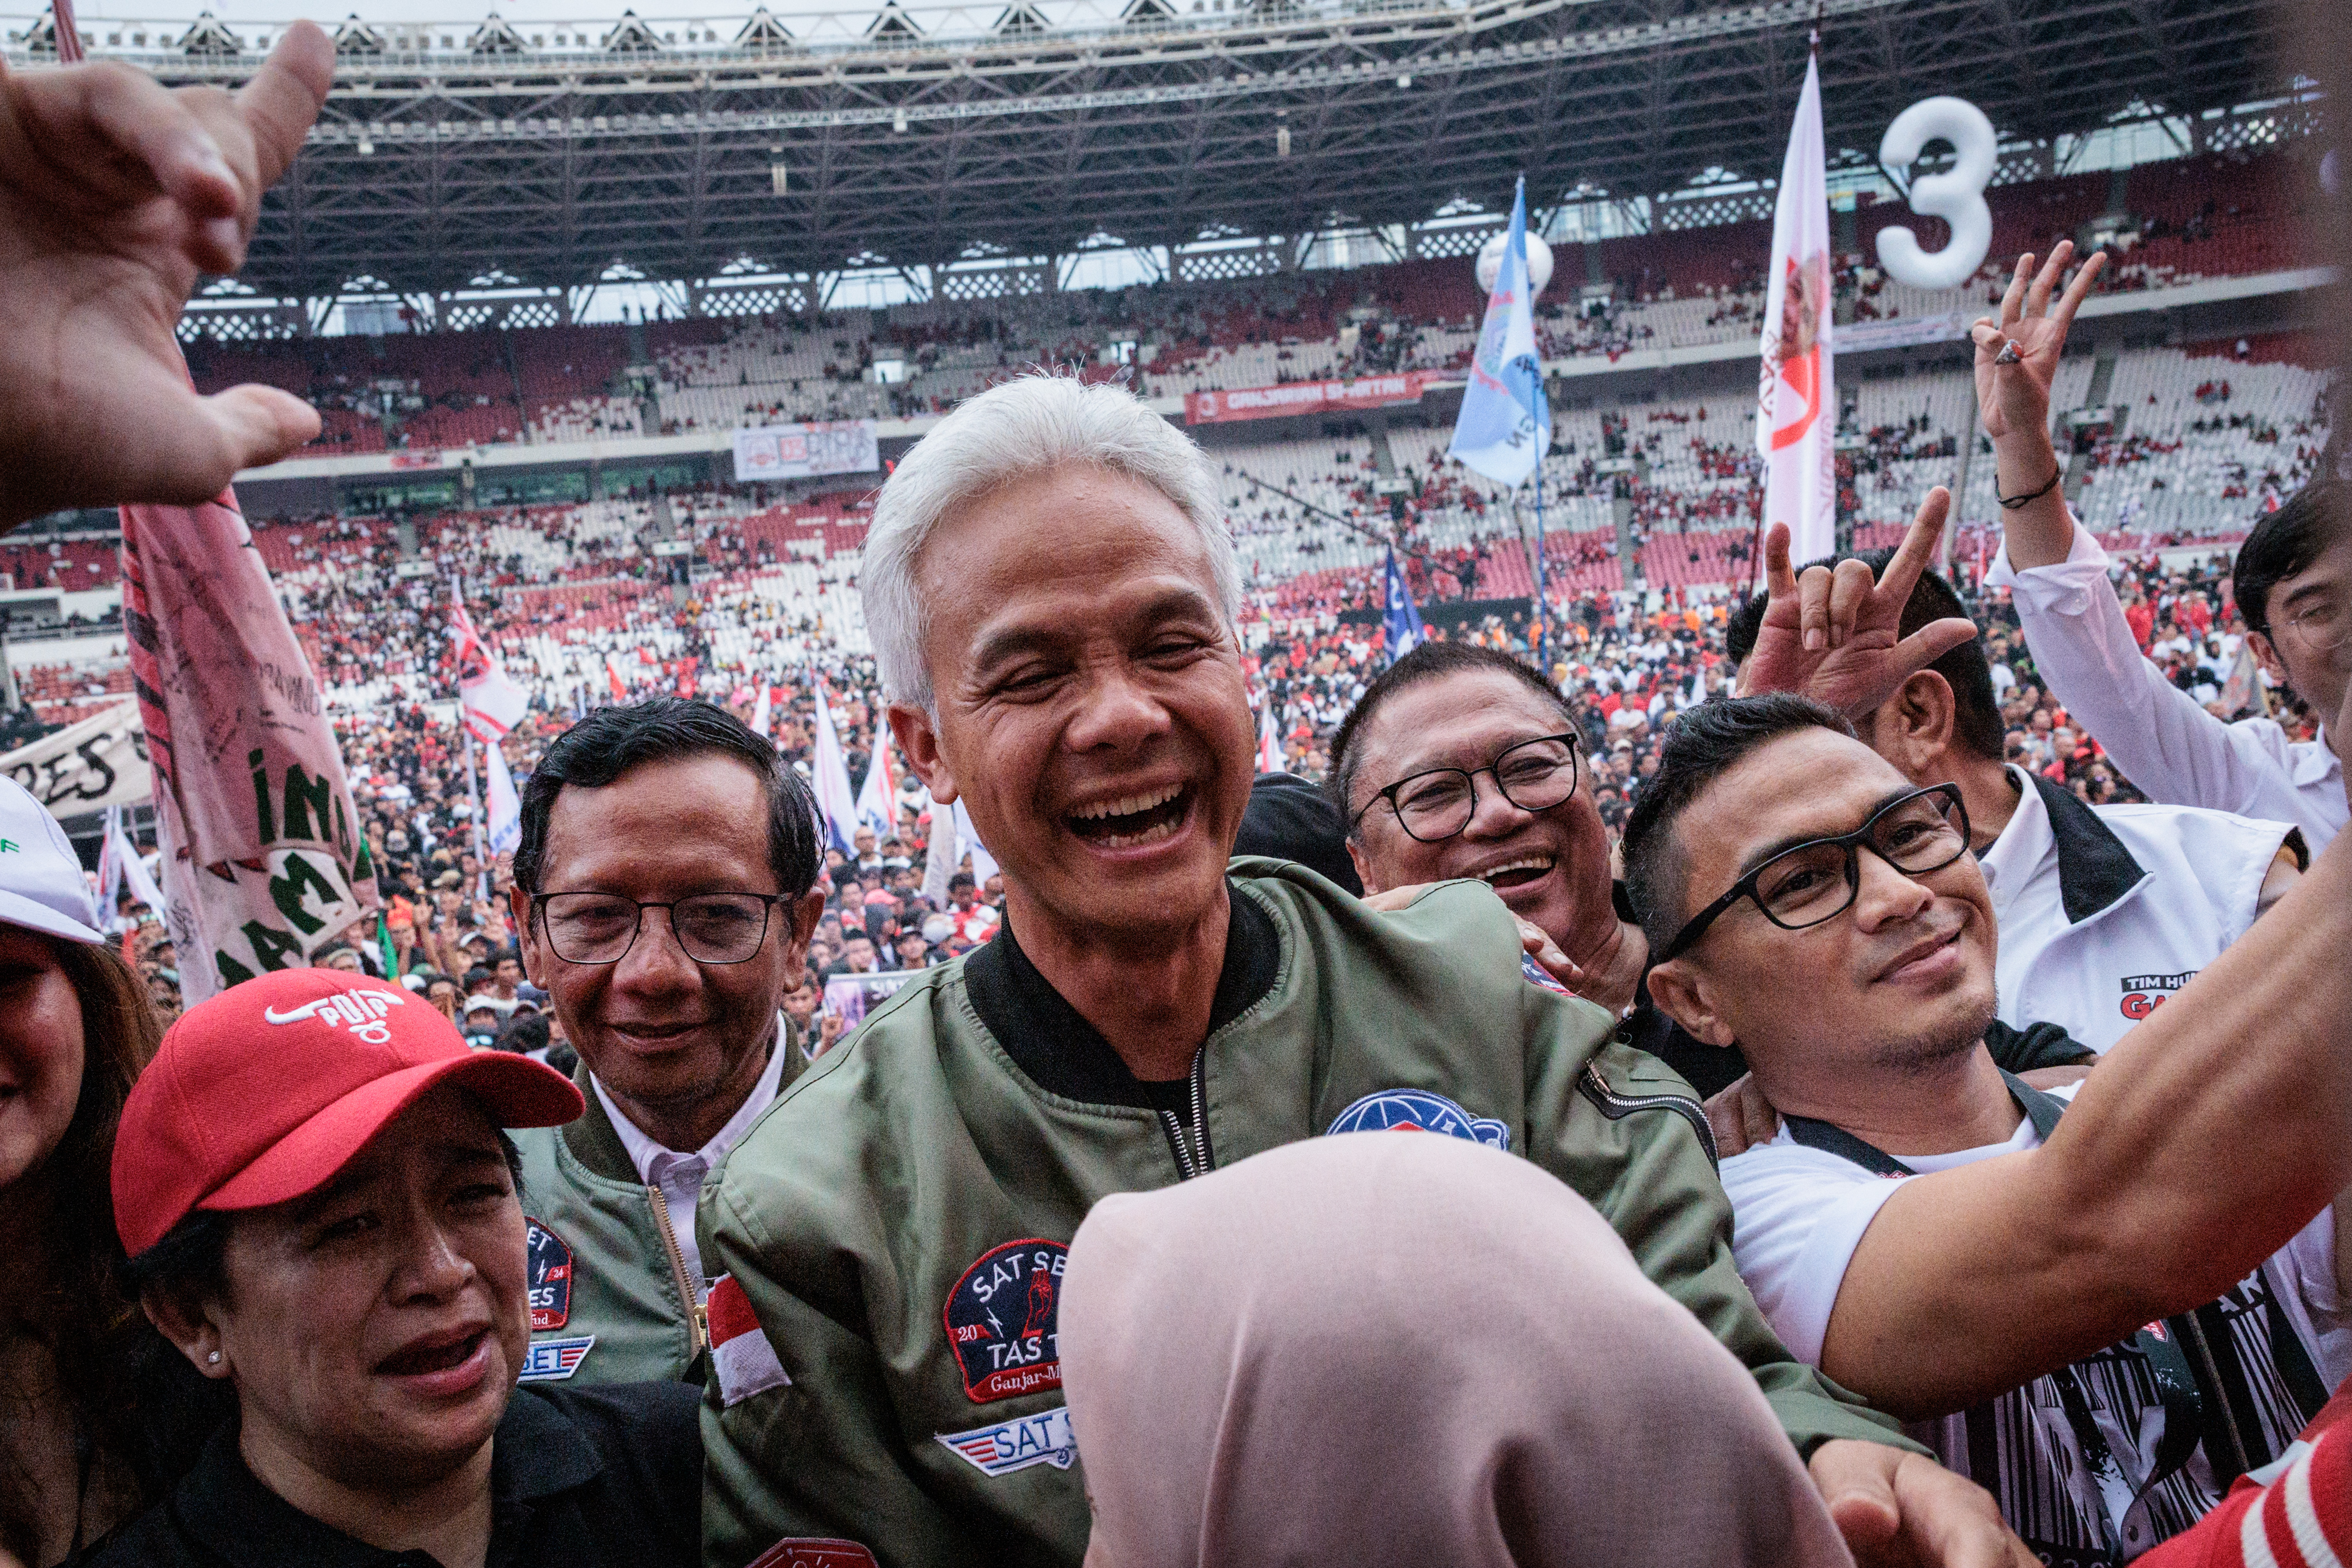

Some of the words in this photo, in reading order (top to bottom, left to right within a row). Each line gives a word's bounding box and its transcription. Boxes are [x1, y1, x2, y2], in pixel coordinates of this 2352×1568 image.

[1876, 96, 1997, 289] 3
[2127, 976, 2161, 989] TIM
[554, 1267, 564, 1278] 24
[973, 1253, 1024, 1303] SAT
[958, 1325, 977, 1342] 20
[986, 1336, 1042, 1369] TAS
[995, 1415, 1053, 1458] SAT
